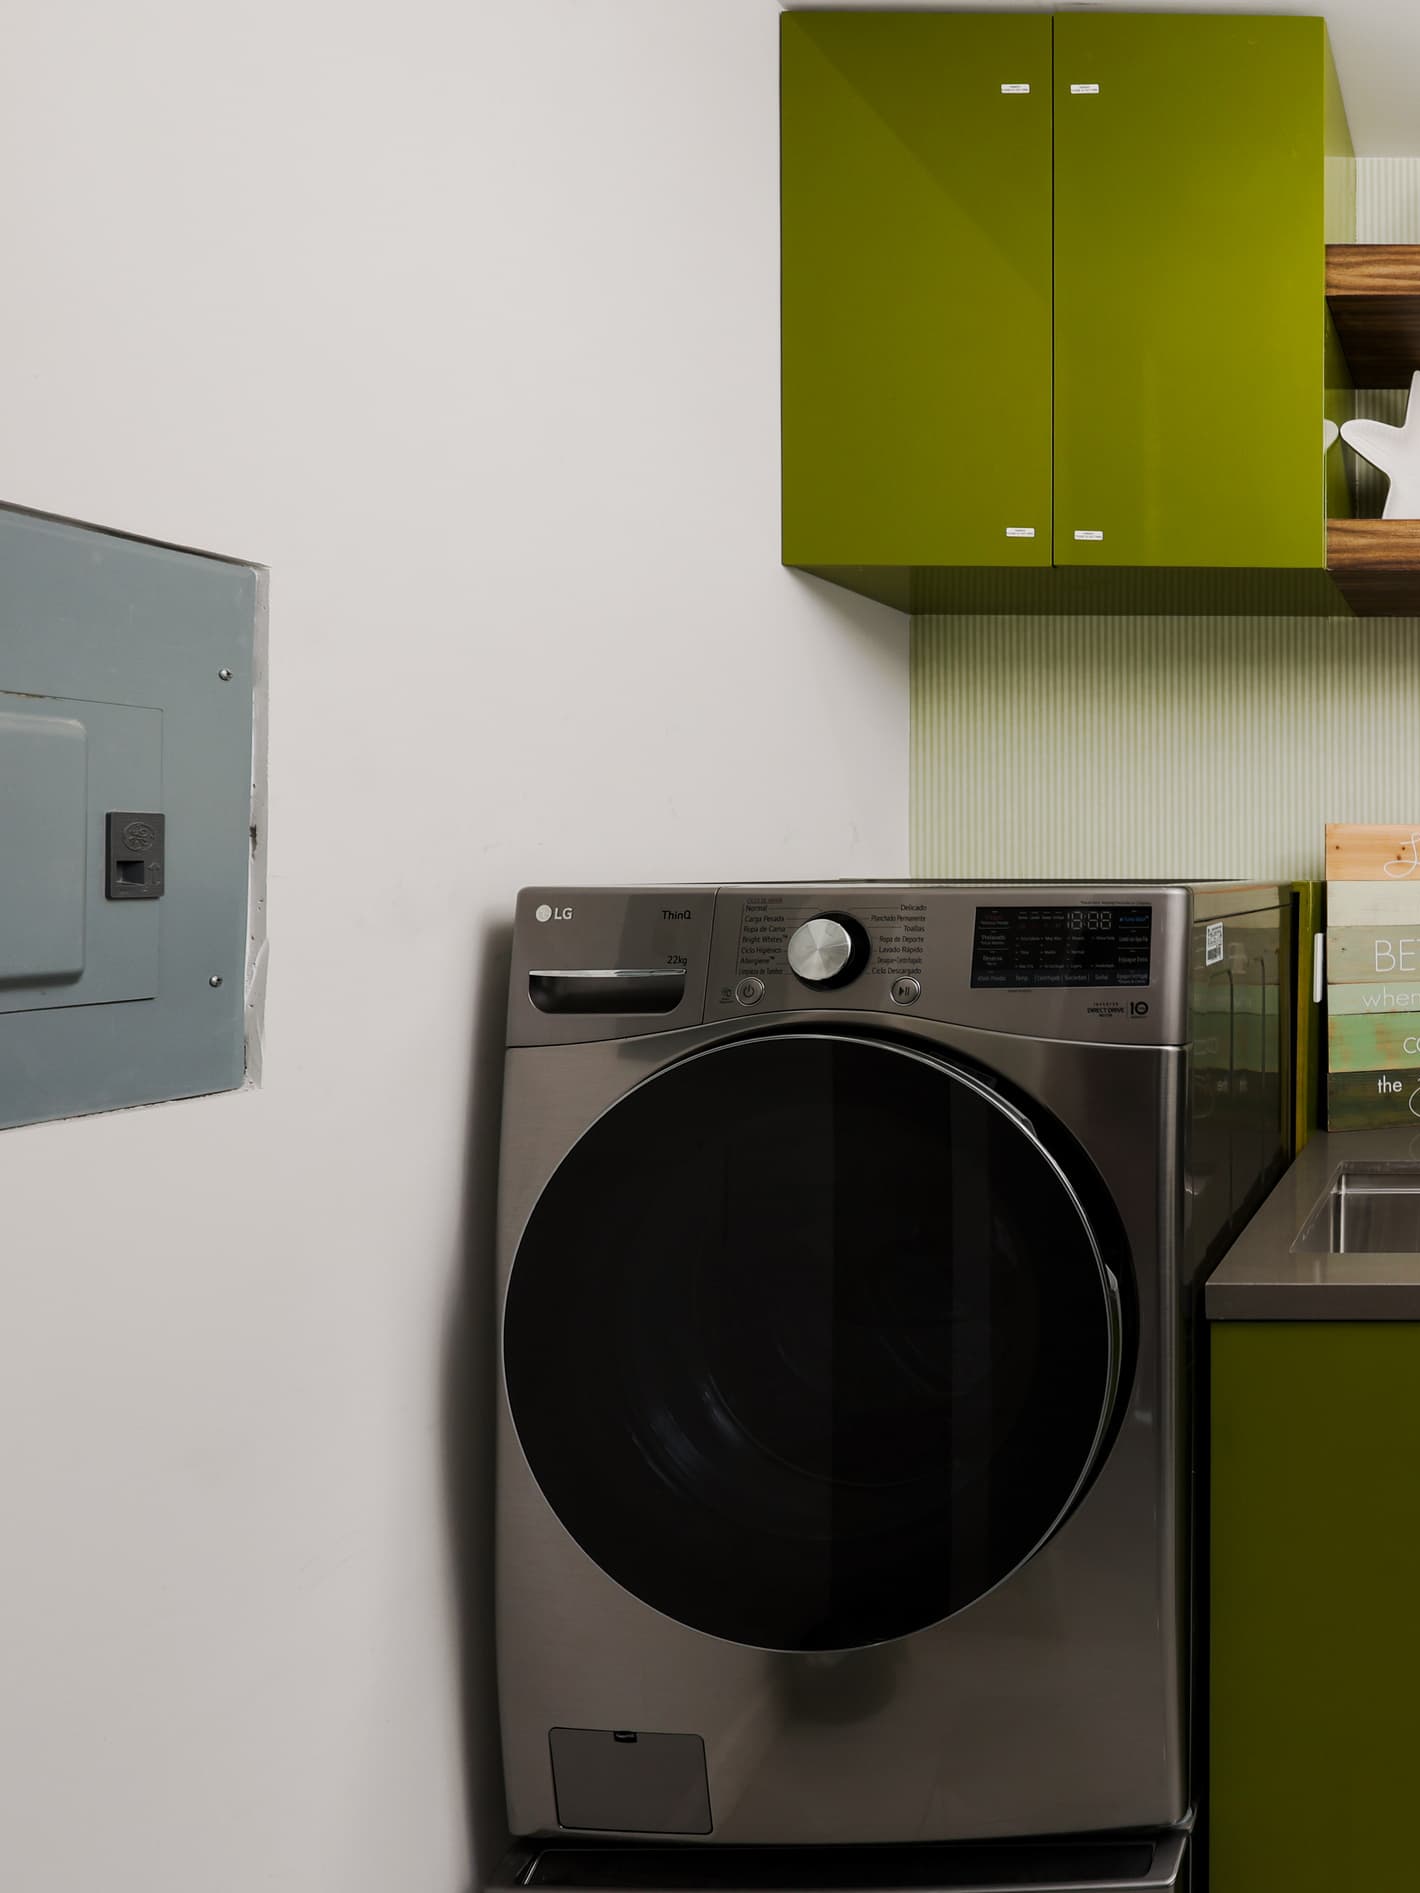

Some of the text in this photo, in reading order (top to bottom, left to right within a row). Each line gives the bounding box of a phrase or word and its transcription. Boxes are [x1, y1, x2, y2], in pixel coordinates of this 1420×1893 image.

[554, 907, 573, 920] LG
[662, 910, 692, 921] ThinQ
[667, 955, 688, 967] 22kg
[1377, 1075, 1403, 1094] the
